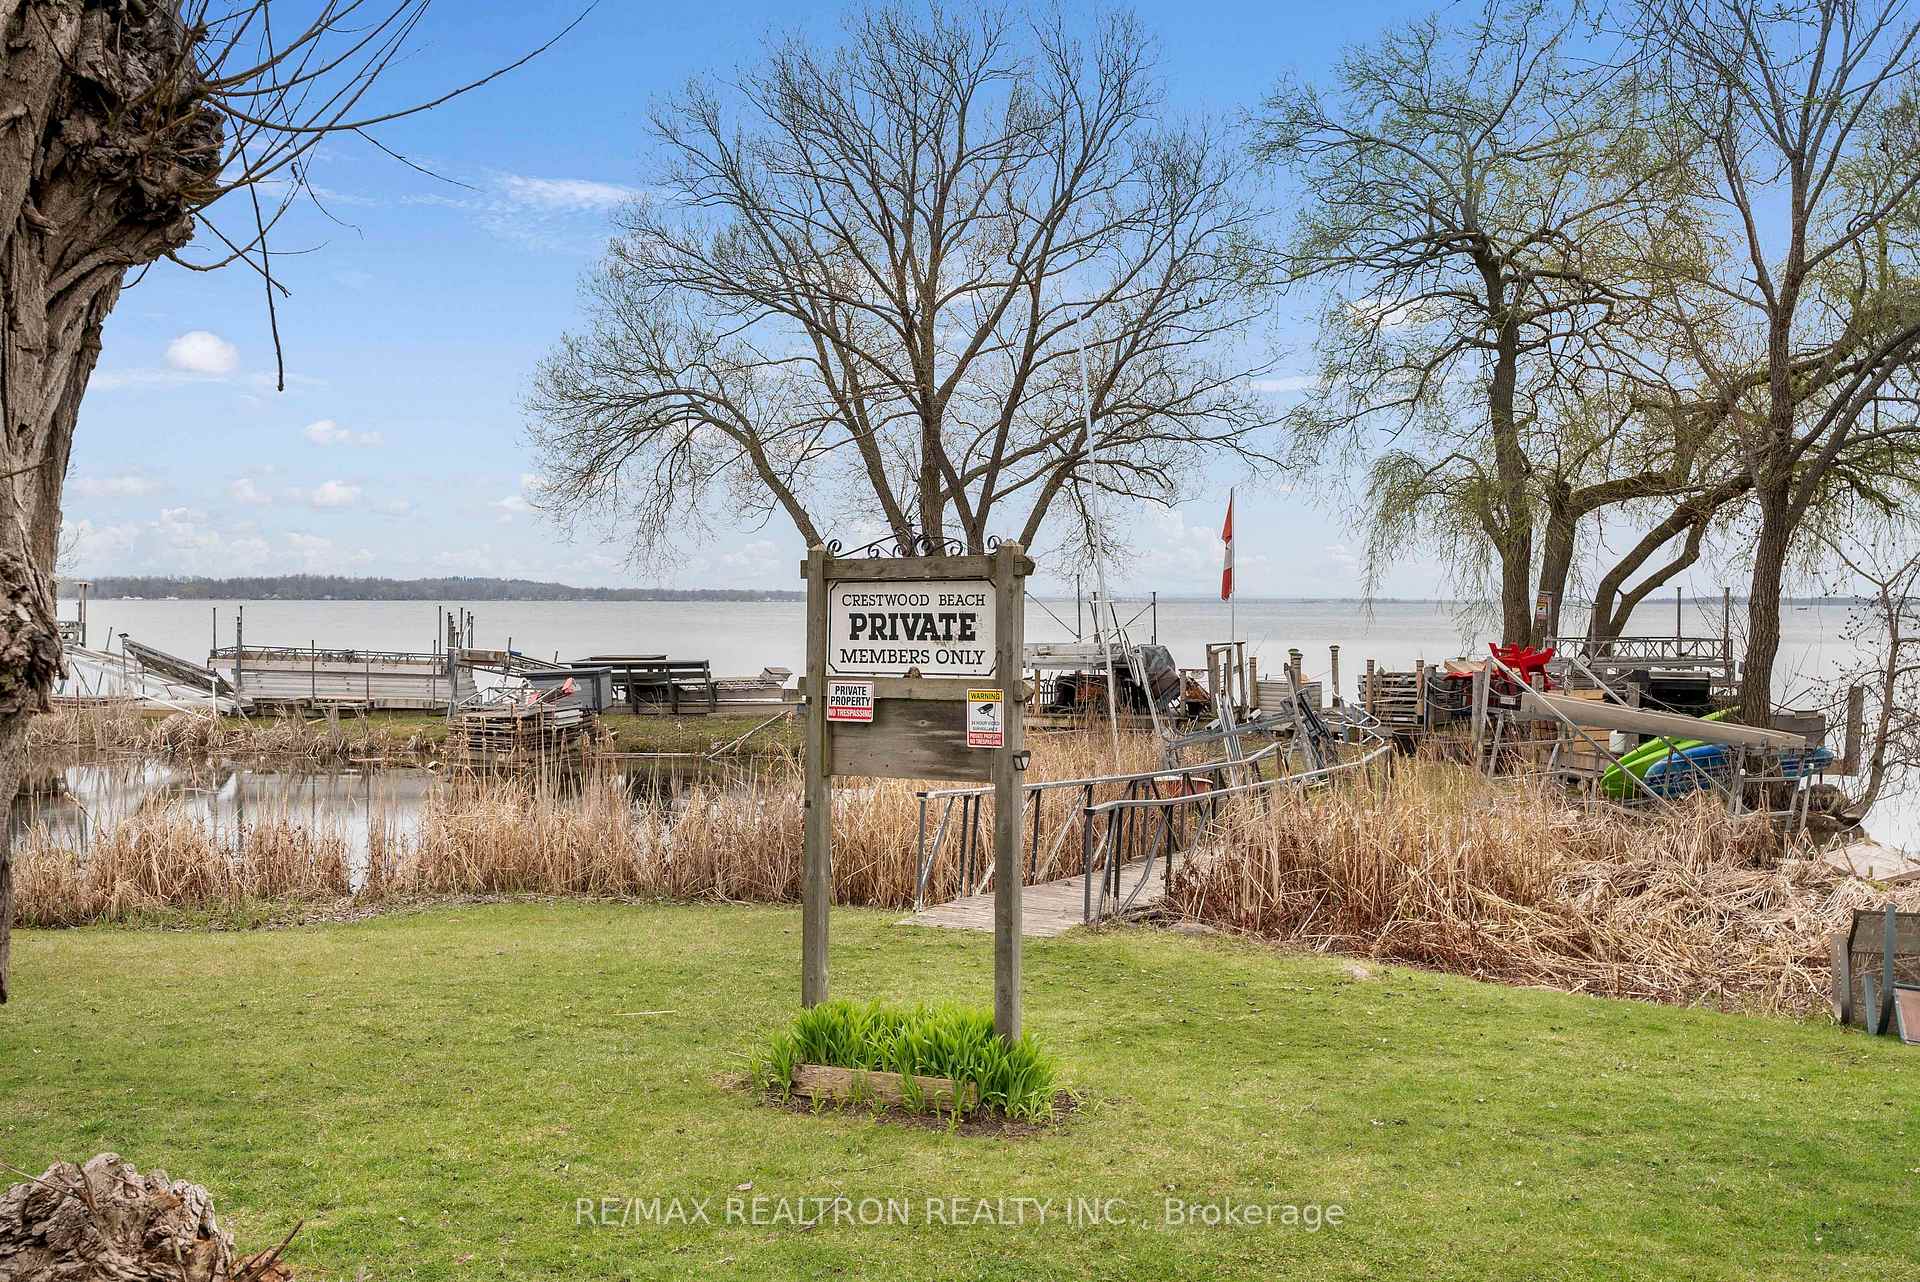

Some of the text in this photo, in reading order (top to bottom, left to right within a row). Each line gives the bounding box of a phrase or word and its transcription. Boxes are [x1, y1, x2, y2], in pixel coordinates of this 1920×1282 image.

[841, 594, 986, 607] CRESTWOOD BEACH
[848, 612, 977, 641] PRIVATE
[839, 648, 985, 665] MEMBERS ONLY
[835, 685, 867, 696] PRIVATE
[970, 692, 1000, 700] WARNING
[830, 696, 871, 706] PROPERTY
